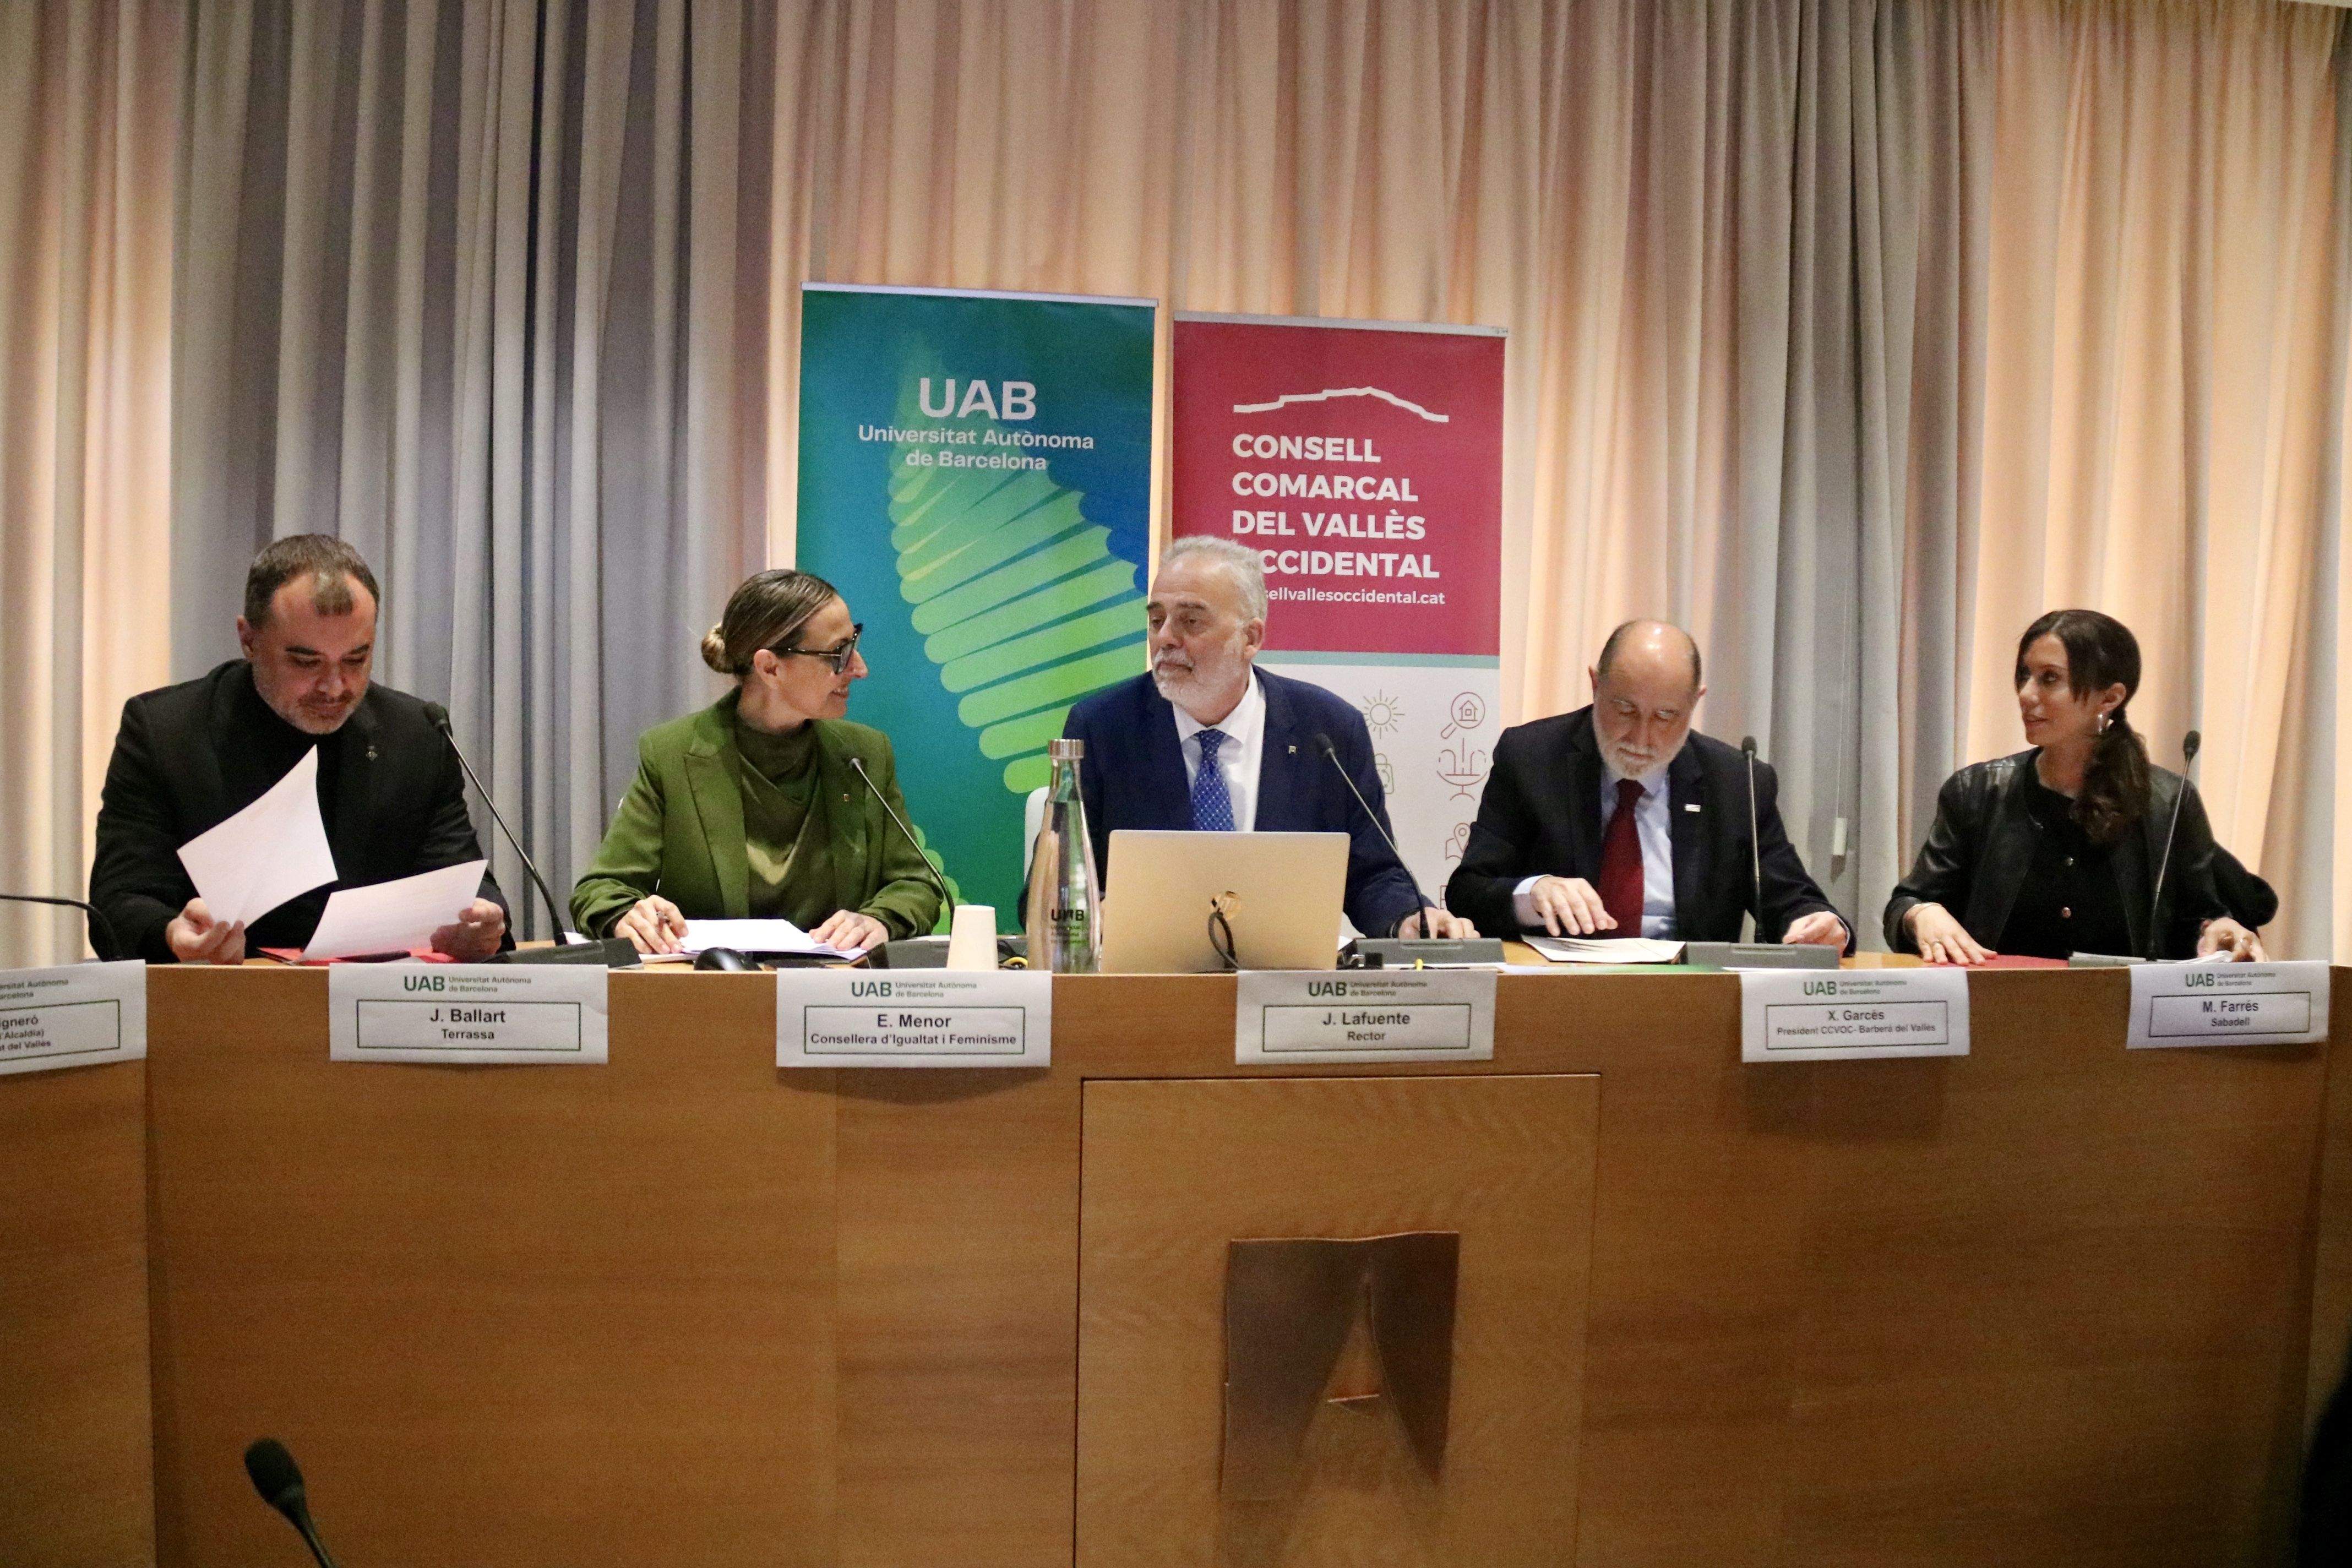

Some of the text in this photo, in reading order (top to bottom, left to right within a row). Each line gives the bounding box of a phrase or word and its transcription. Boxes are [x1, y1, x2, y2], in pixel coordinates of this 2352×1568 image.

[919, 377, 1037, 420] UAB
[858, 424, 1094, 450] Universitat Autònoma
[1232, 433, 1381, 462] CONSELL
[906, 449, 1047, 471] de Barcelona
[1232, 471, 1419, 502] COMARCAL
[1232, 509, 1426, 541] DEL VALLÈS
[1259, 549, 1440, 579] CCIDENTAL
[1265, 586, 1446, 605] ellvallesoccidental.cat
[404, 975, 445, 992] UAB
[2185, 973, 2215, 987] UAB
[851, 982, 892, 998] UAB
[1308, 981, 1348, 997] UAB
[1803, 981, 1837, 996] UAB
[2202, 999, 2260, 1013] M. Farrés
[0, 1014, 39, 1030] gneró
[430, 1008, 507, 1023] J. Ballart
[877, 1014, 952, 1028] E. Menor
[1322, 1011, 1411, 1026] J. Lafuente
[1827, 1010, 1839, 1021] X.
[2211, 1017, 2251, 1027] Sabadell
[441, 1028, 495, 1039] Terrassa
[810, 1033, 878, 1044] Consellera
[941, 1033, 946, 1044] i
[949, 1033, 1017, 1045] Feminisme
[1347, 1031, 1386, 1041] Rector
